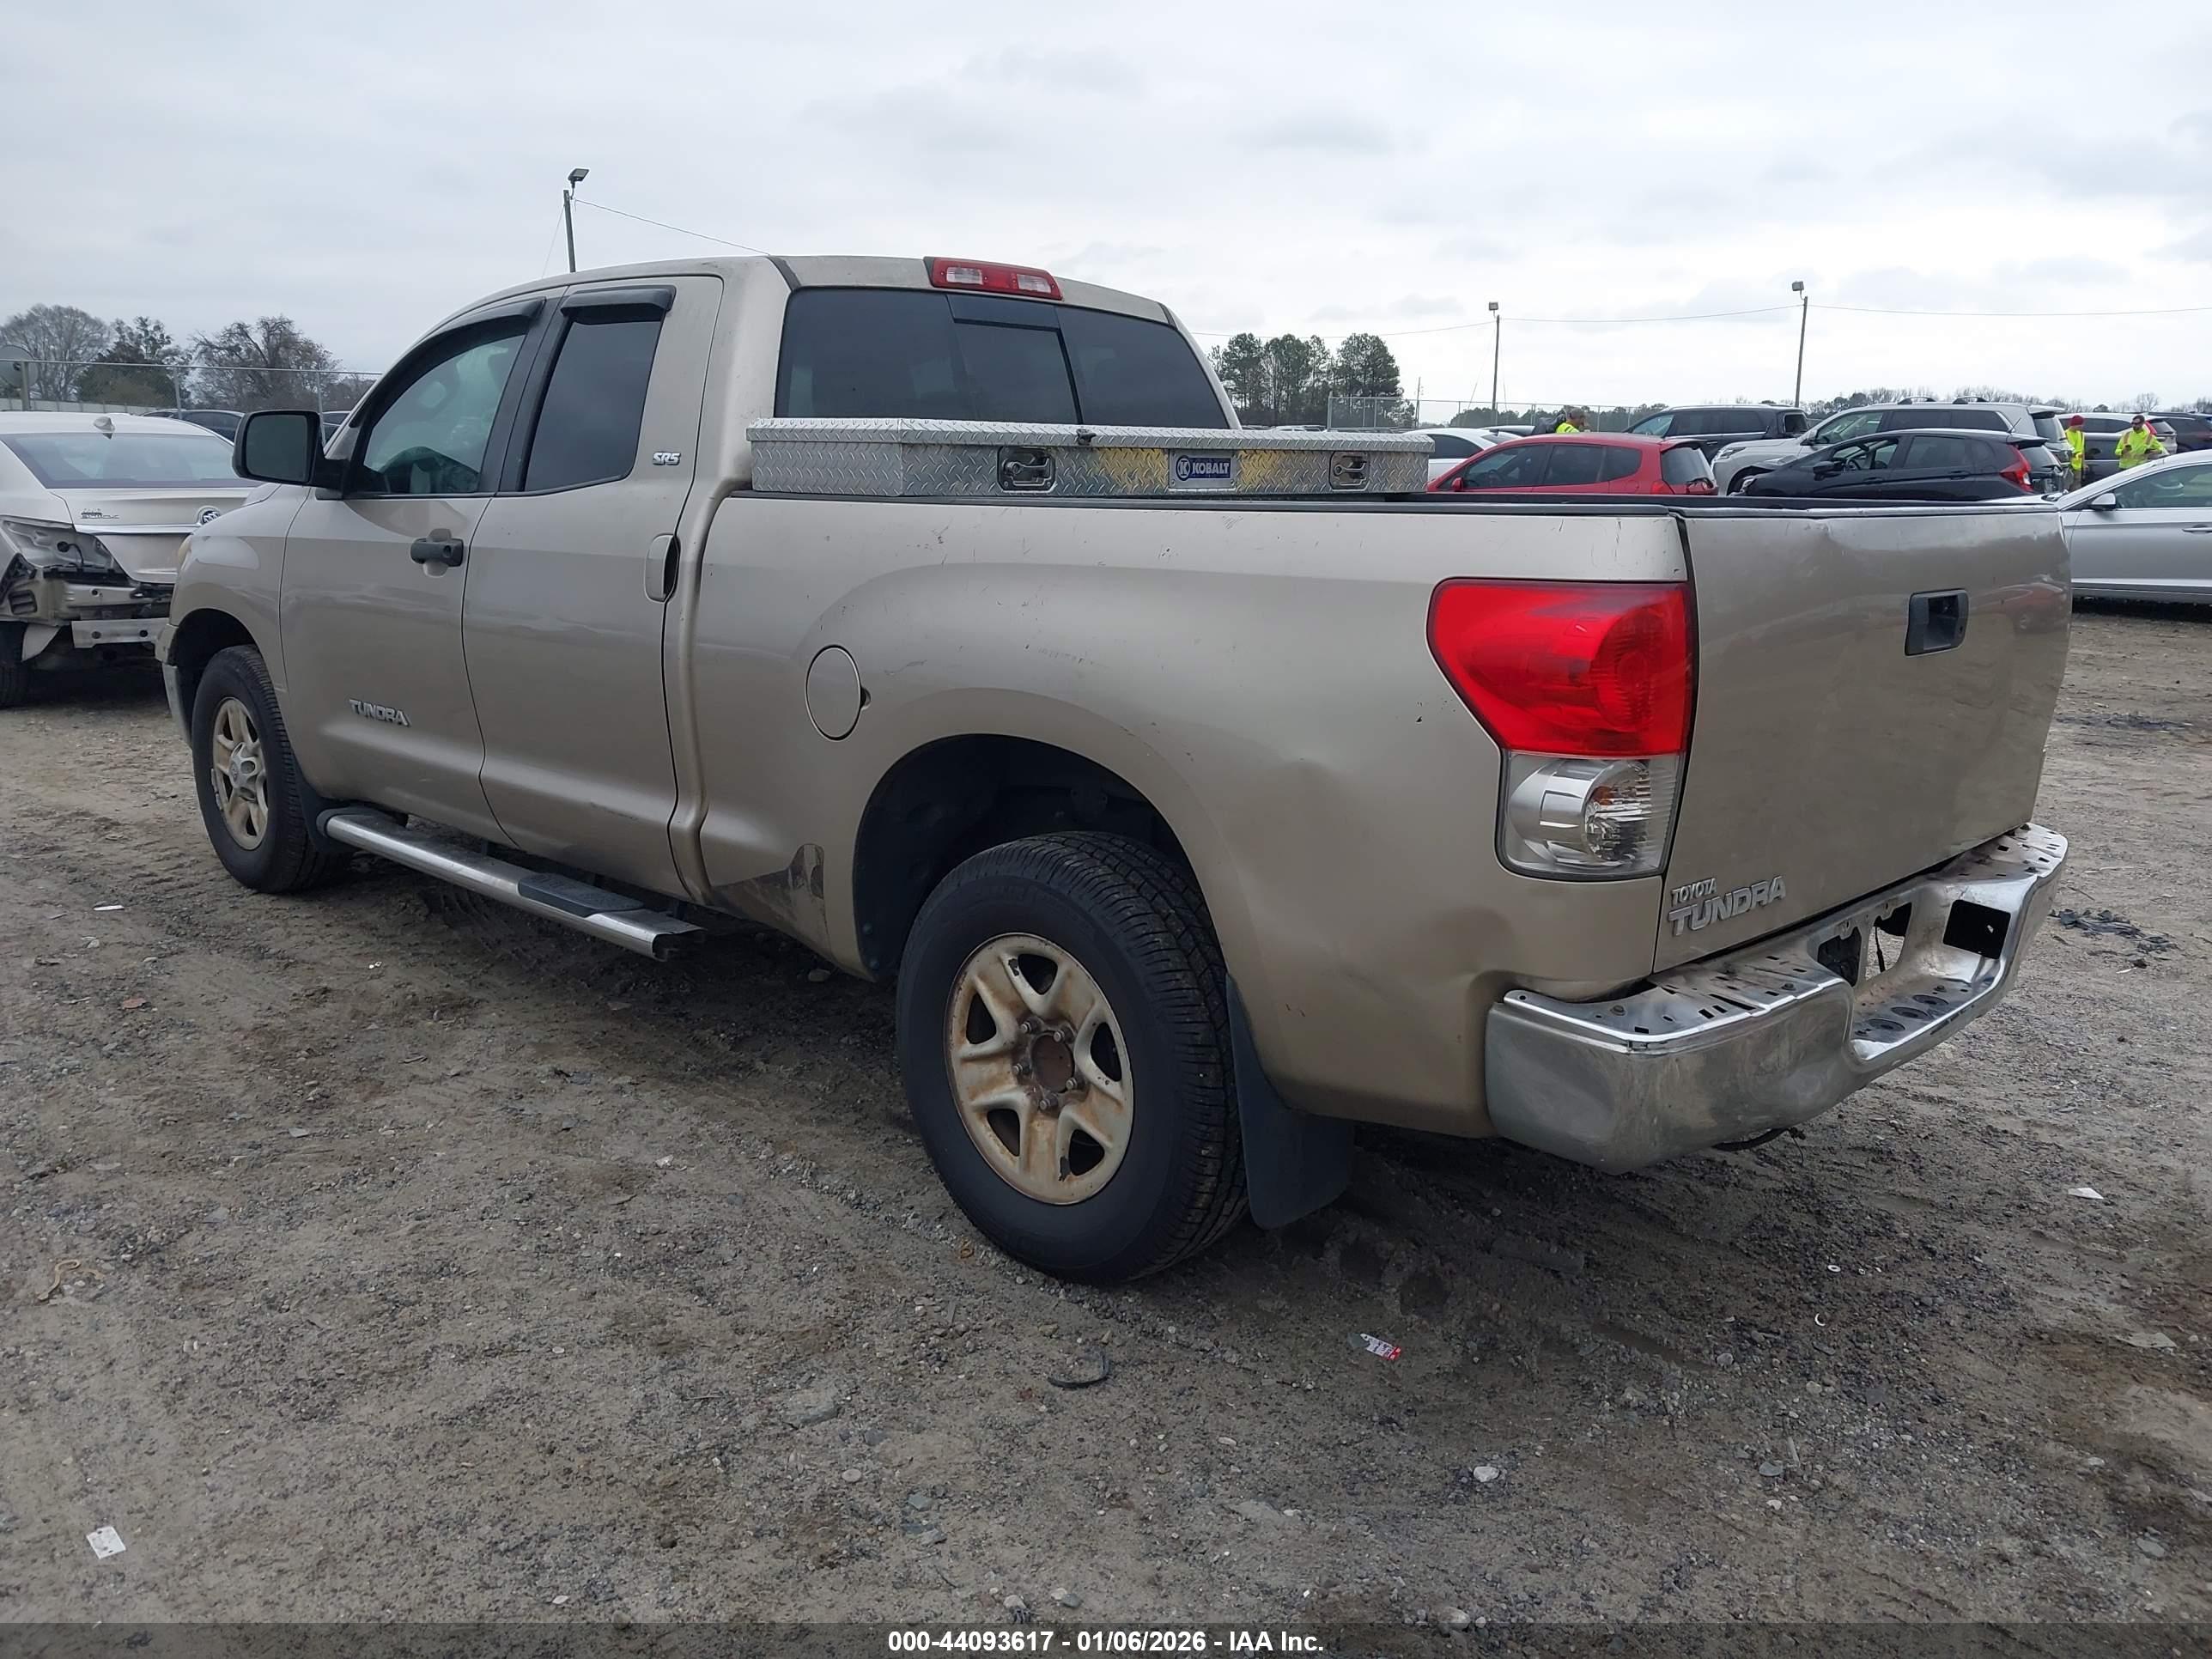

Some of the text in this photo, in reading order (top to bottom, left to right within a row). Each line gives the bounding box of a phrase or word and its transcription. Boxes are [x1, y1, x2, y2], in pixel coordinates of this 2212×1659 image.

[653, 452, 680, 465] SR5
[1192, 462, 1230, 475] KOBALT
[349, 698, 410, 726] TUNDRA
[1672, 878, 1717, 905] TOYOTA
[1668, 875, 1787, 936] TUNDRA
